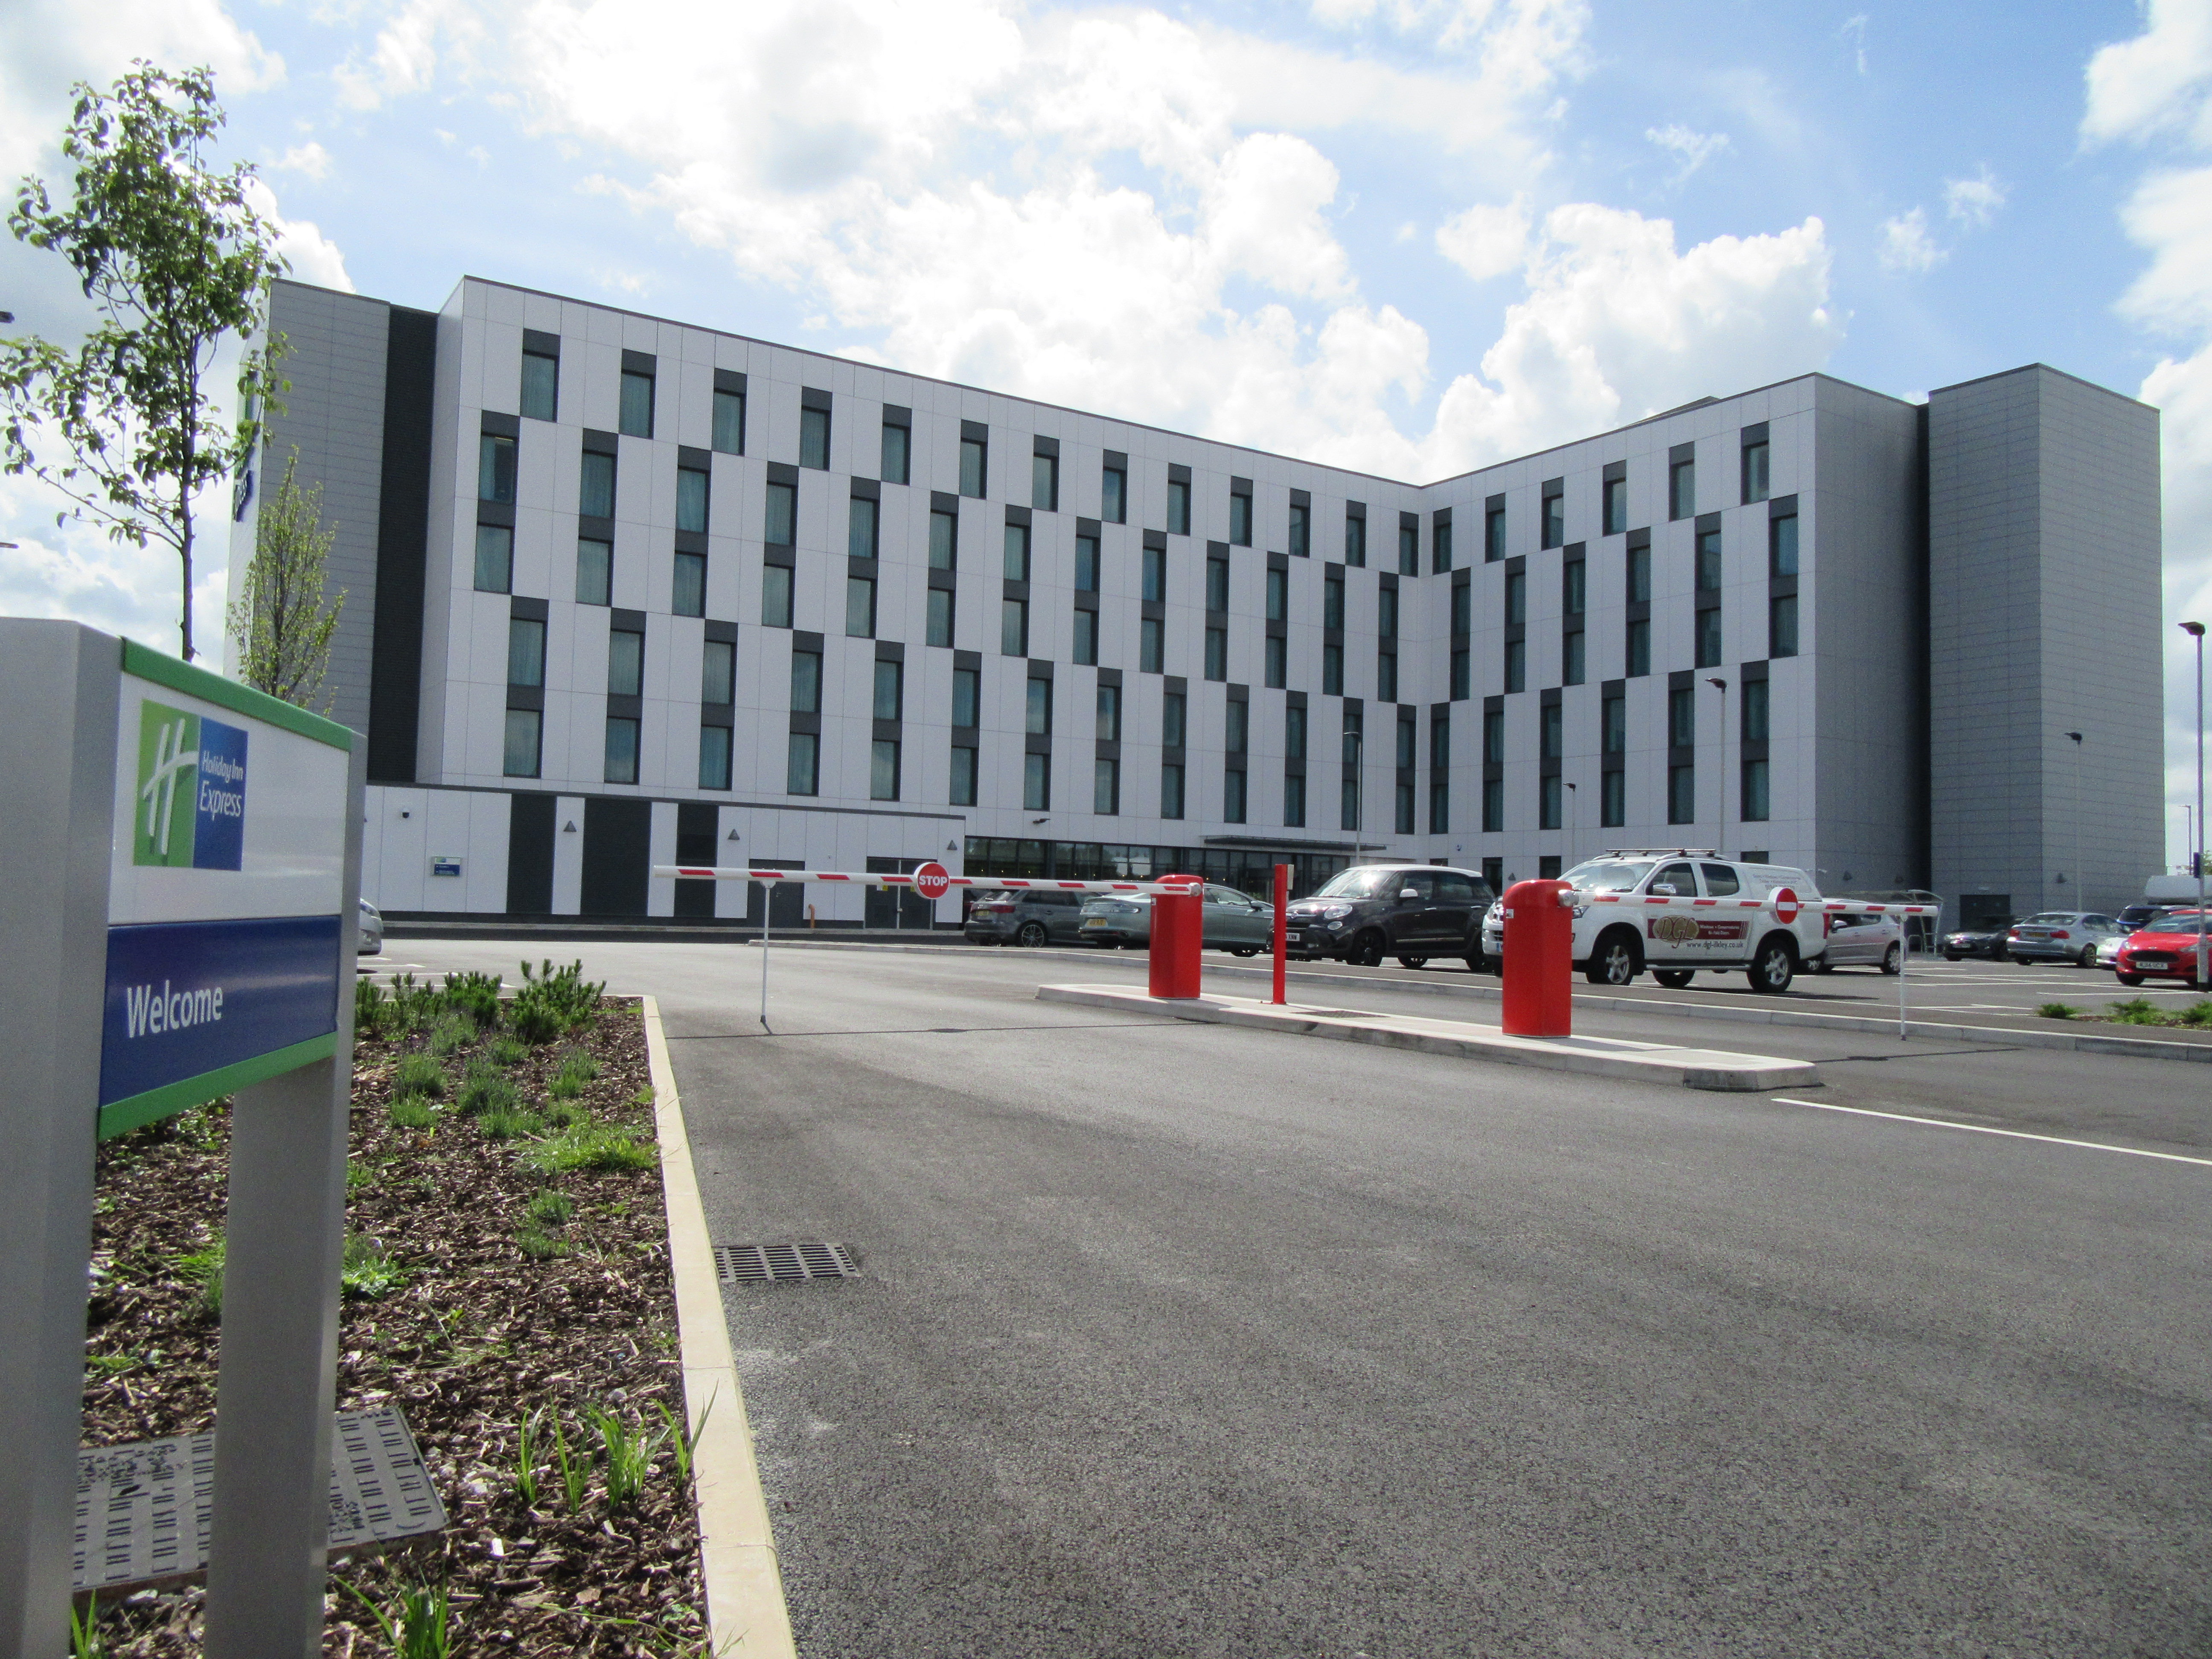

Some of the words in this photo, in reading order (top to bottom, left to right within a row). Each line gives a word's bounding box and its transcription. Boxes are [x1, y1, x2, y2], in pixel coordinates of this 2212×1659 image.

[202, 750, 231, 783] Holiday
[232, 758, 243, 780] Inn
[200, 780, 242, 821] Express
[919, 875, 948, 886] STOP
[1687, 940, 1743, 950] www.dgl-ilkley.co.uk
[127, 979, 223, 1038] Welcome
